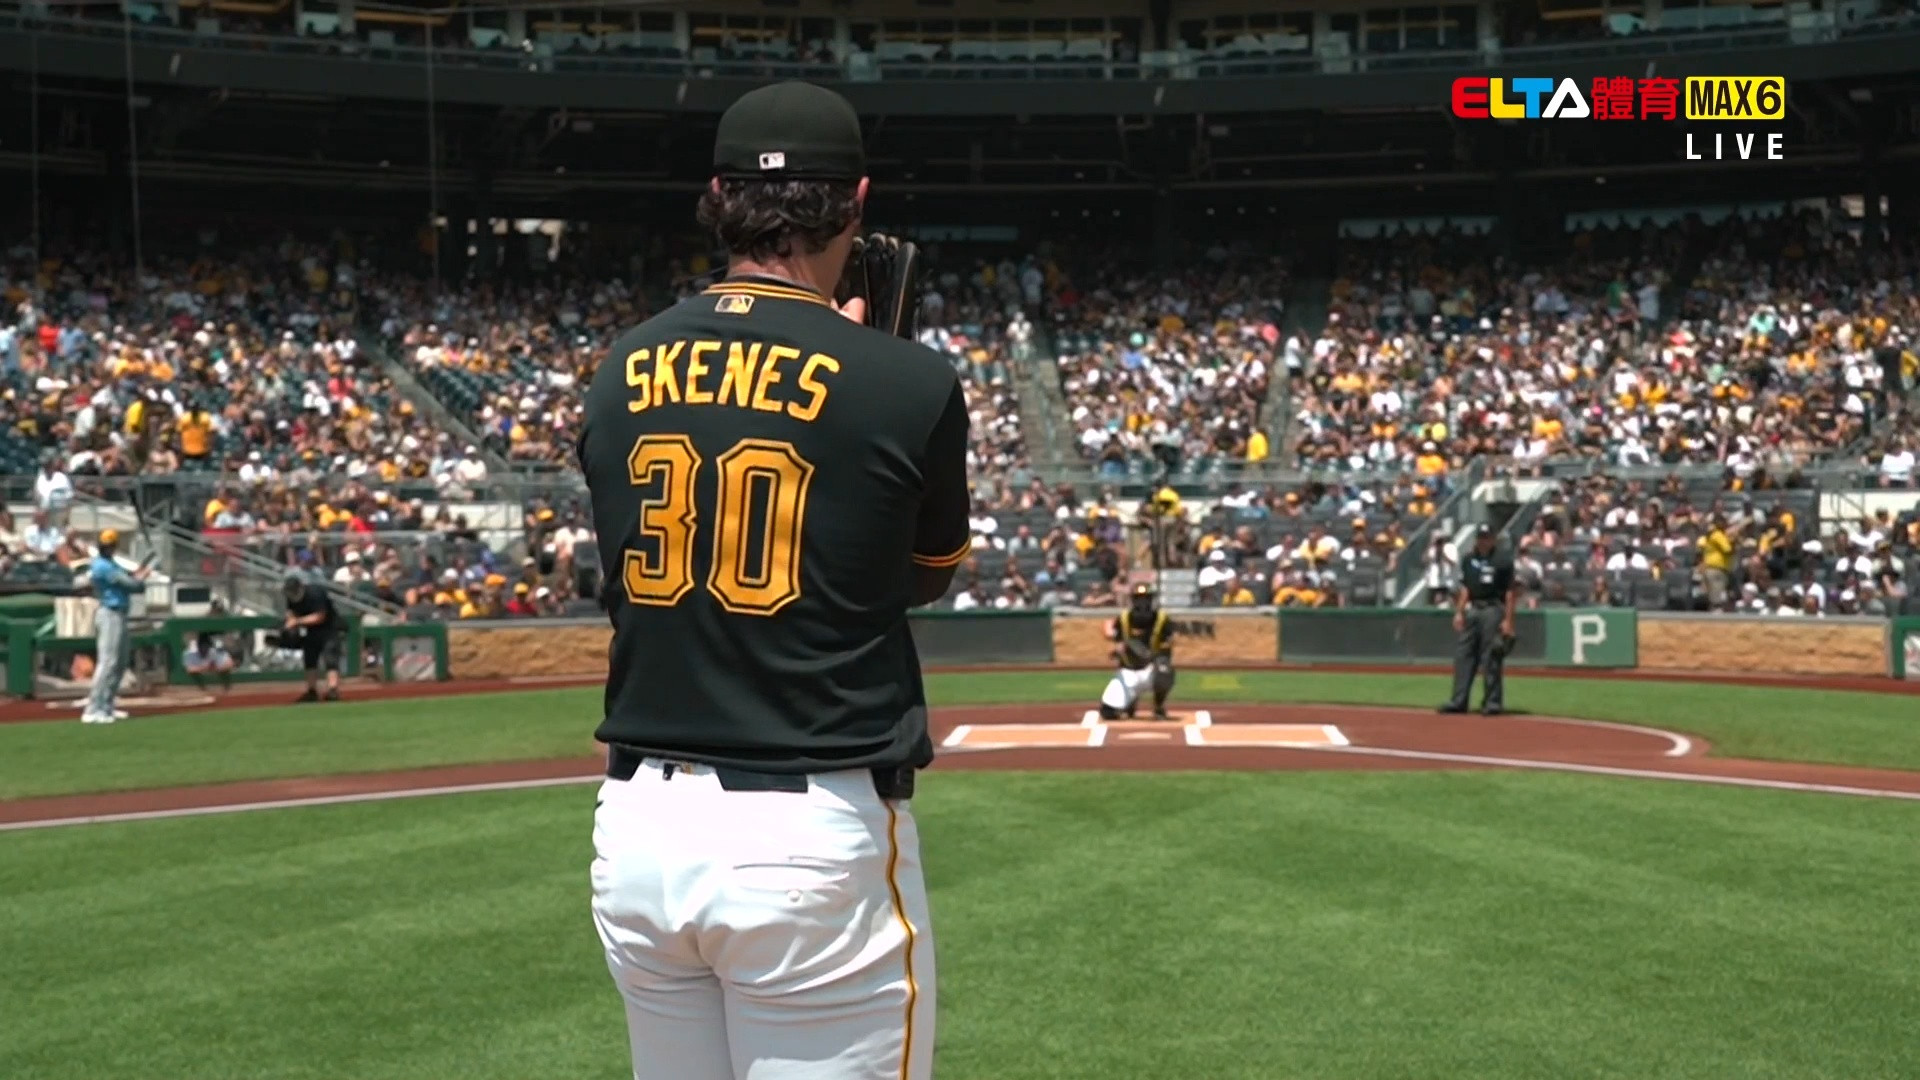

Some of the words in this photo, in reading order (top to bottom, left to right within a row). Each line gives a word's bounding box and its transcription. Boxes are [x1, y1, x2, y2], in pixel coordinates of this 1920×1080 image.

[625, 340, 841, 422] SKENES
[623, 433, 815, 616] 30
[1572, 614, 1607, 665] P
